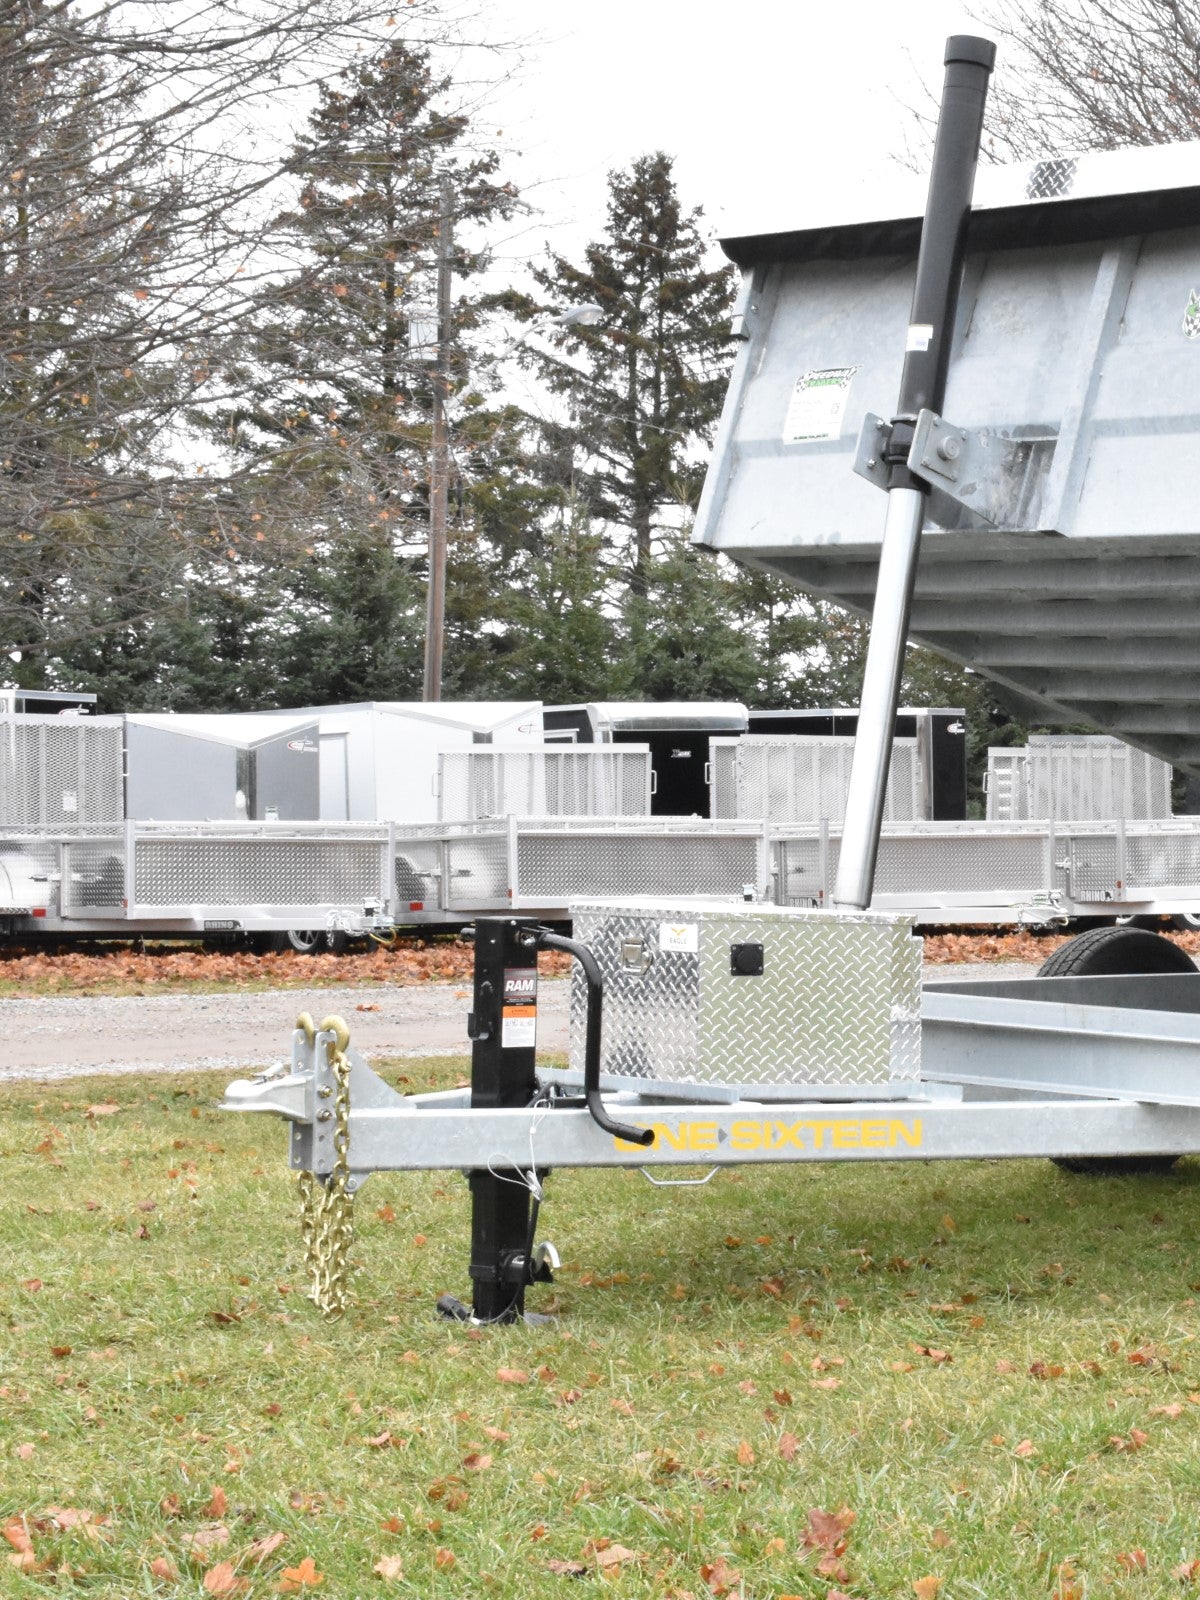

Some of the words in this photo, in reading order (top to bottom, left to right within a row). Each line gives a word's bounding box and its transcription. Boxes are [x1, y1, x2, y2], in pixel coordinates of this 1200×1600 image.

[1080, 890, 1105, 902] RHINO
[205, 920, 234, 929] RHINO
[669, 937, 687, 945] EAGLE
[505, 979, 534, 992] RAM
[729, 1119, 922, 1151] SIXTEEN
